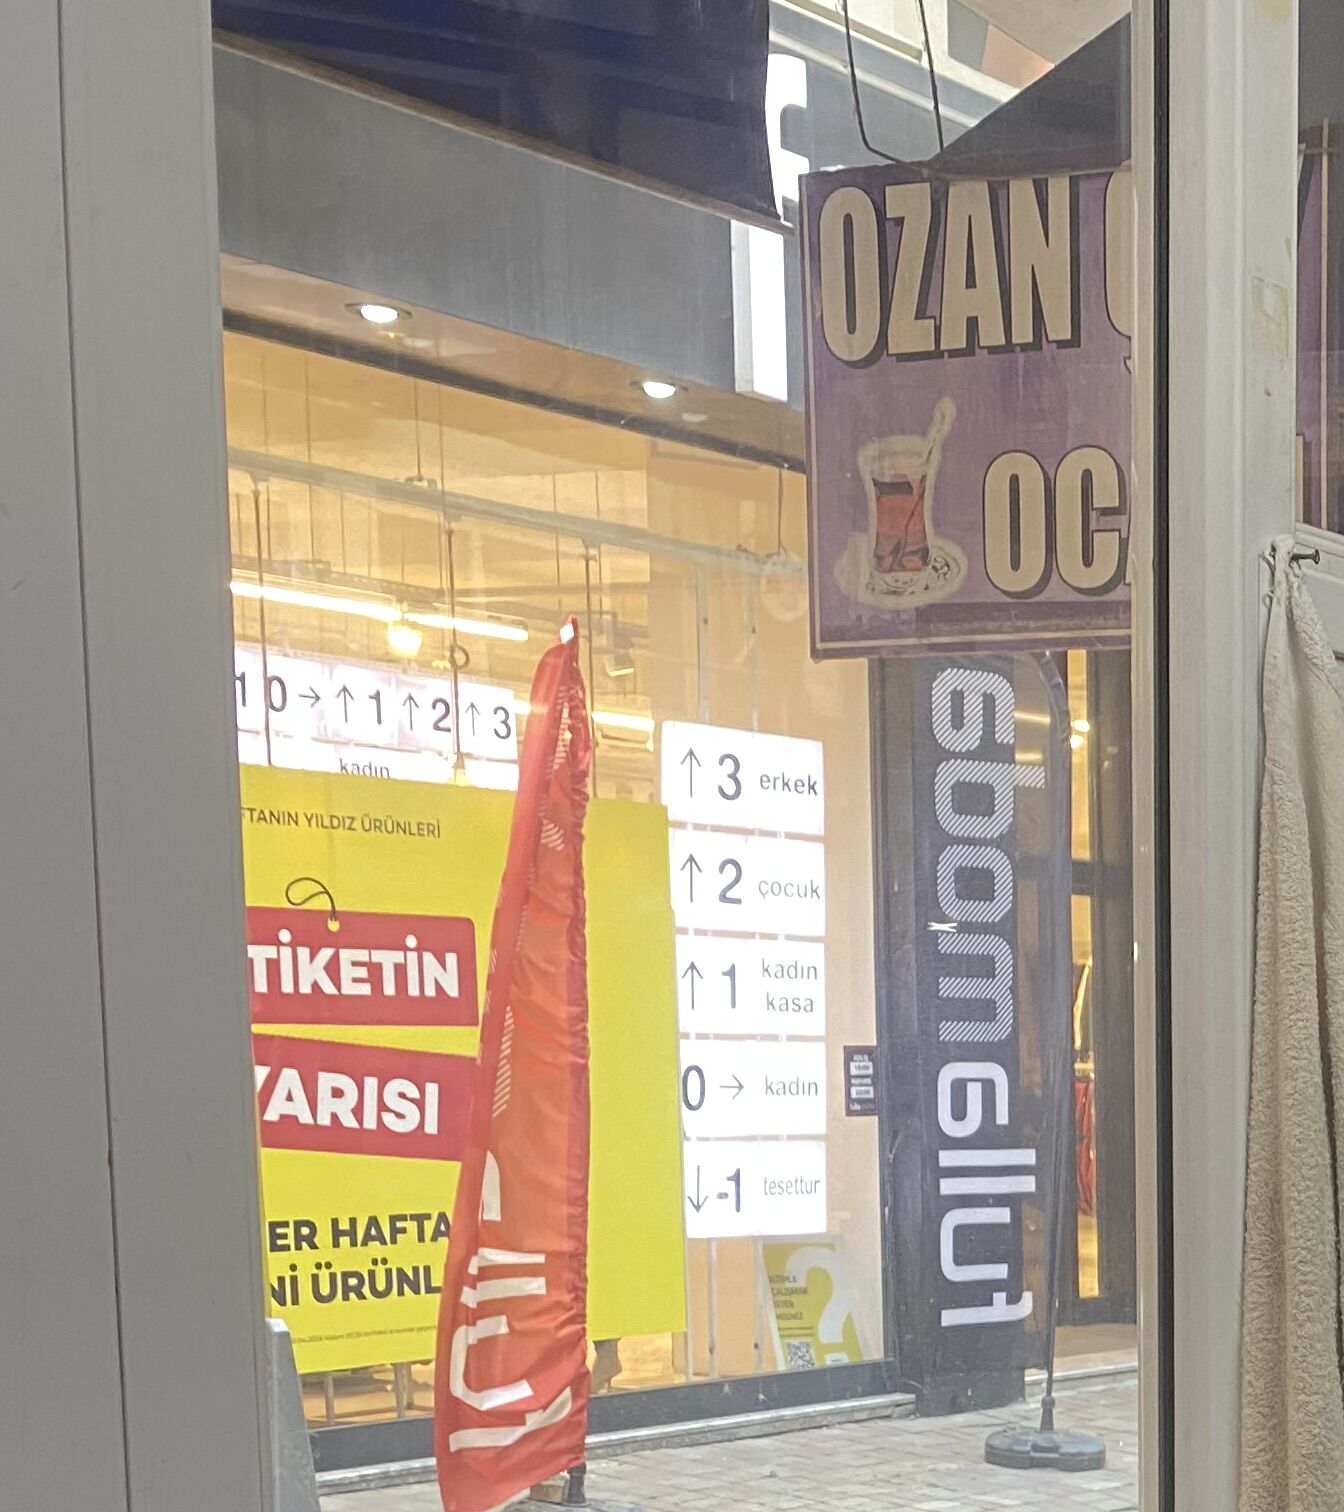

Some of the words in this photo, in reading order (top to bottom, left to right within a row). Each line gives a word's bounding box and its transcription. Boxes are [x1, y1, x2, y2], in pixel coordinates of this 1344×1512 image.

[819, 176, 1081, 366] OZAN
[983, 446, 1131, 597] OC
[267, 675, 287, 712] 0
[368, 689, 382, 725] 1
[432, 698, 451, 732] 2
[493, 706, 512, 740] 3
[717, 753, 741, 800] 3
[759, 770, 818, 797] erkek
[303, 812, 356, 832] YILDIZ
[361, 813, 440, 838] ÜRÜNLERİ
[718, 858, 742, 905] 2
[758, 877, 821, 901] çocuk
[721, 963, 737, 1008] 1
[761, 958, 818, 981] kadın
[766, 991, 814, 1013] kasa
[681, 1065, 705, 1111] 0
[764, 1074, 819, 1097] kadın
[717, 1168, 740, 1212] -1
[763, 1175, 821, 1196] tesettur
[331, 1211, 450, 1249] HAFTA
